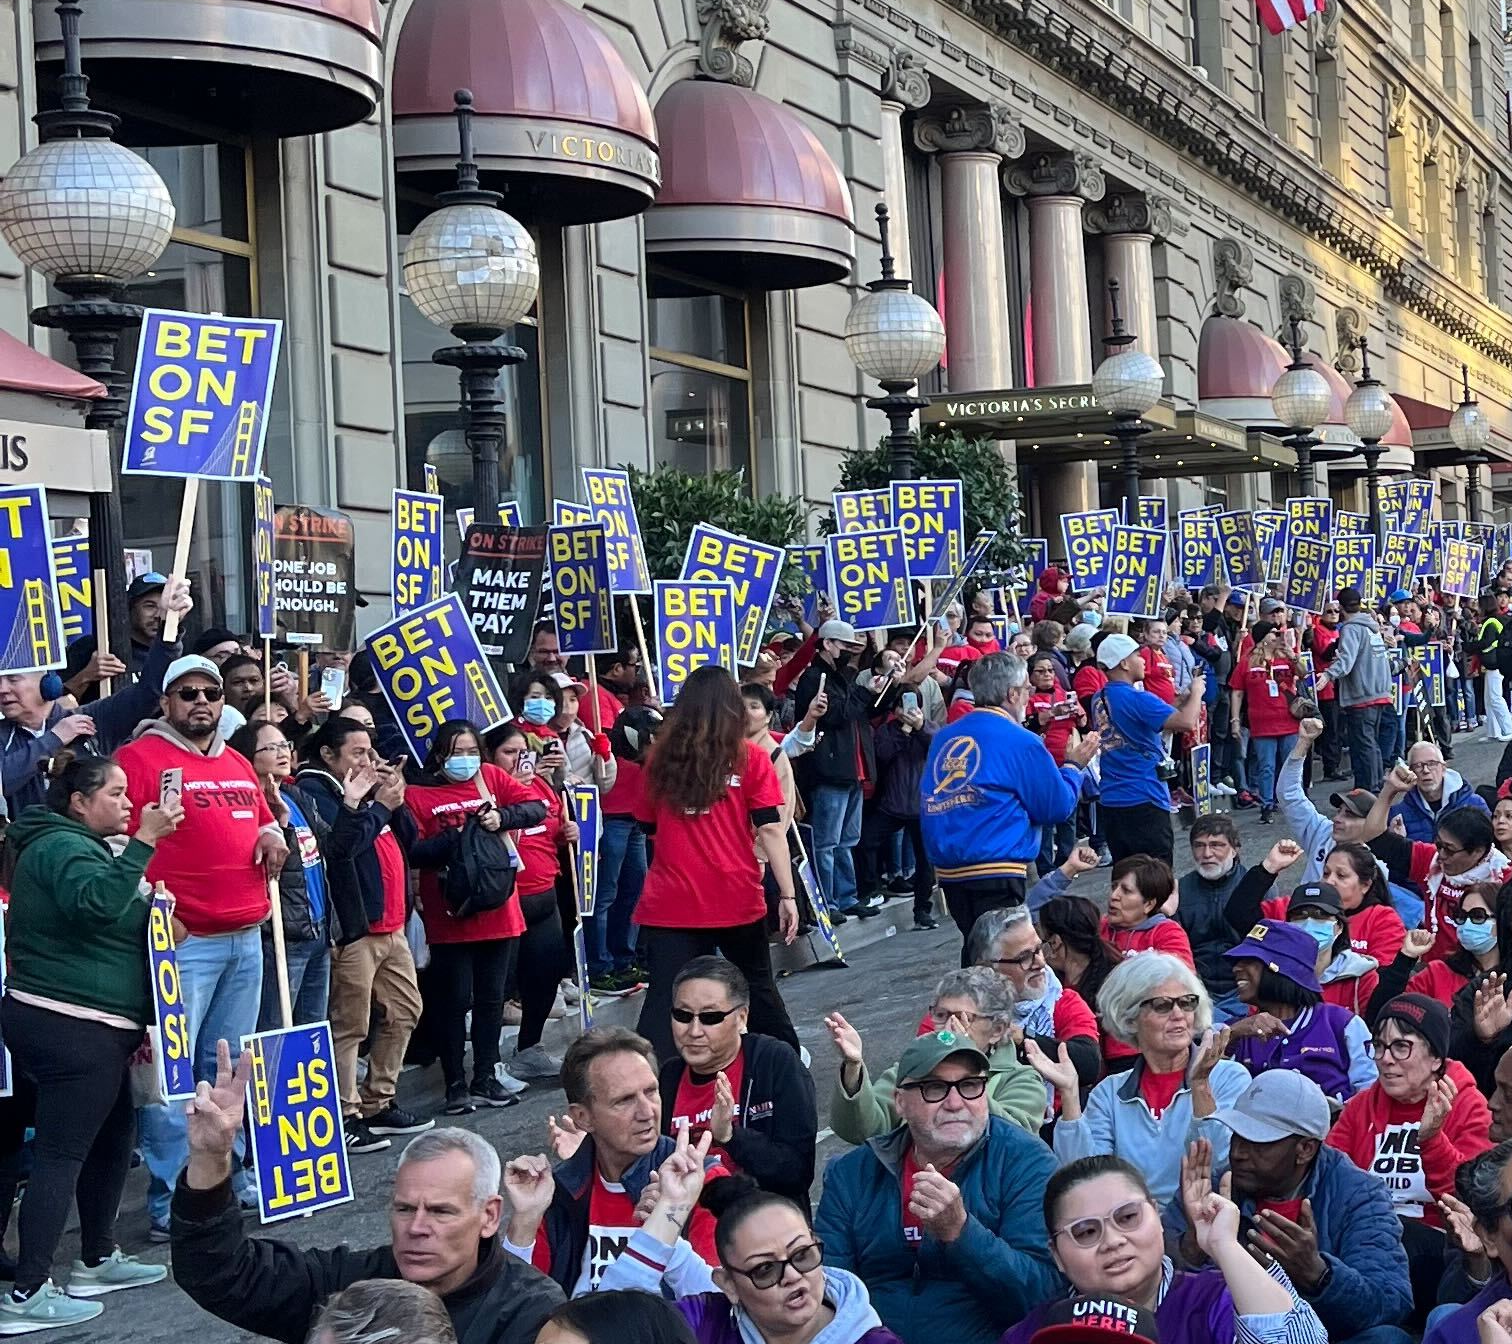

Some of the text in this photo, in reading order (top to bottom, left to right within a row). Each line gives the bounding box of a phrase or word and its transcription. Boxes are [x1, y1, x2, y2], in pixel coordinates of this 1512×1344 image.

[155, 319, 268, 365] BET
[148, 363, 237, 407] ON
[947, 397, 1043, 417] VICTORIA'S
[140, 406, 215, 446] SF
[589, 476, 627, 505] BET
[898, 485, 956, 509] BET
[1377, 484, 1407, 500] BET
[397, 498, 440, 534] BET
[841, 493, 890, 519] BET
[1139, 501, 1163, 518] ET
[1291, 502, 1329, 519] BET
[1379, 498, 1403, 512] ON
[289, 513, 348, 536] STRIKE
[597, 509, 630, 538] ON
[899, 511, 945, 536] ON
[1068, 513, 1114, 537] BET
[1184, 522, 1218, 539] BET
[1221, 514, 1251, 535] BET
[1290, 519, 1320, 536] ON
[1339, 514, 1369, 531] BET
[470, 532, 545, 551] ON STRIKE
[551, 529, 602, 563] BET
[837, 533, 898, 563] BET
[1072, 535, 1109, 556] ON
[1116, 530, 1163, 555] BET
[1184, 540, 1212, 558] ON
[1226, 536, 1252, 554] ON
[1296, 541, 1331, 563] BET
[1335, 539, 1372, 556] BET
[1388, 535, 1419, 552] BET
[1449, 542, 1480, 560] BET
[396, 536, 431, 570] ON
[696, 535, 776, 579] BET
[1385, 550, 1407, 566] ON
[273, 560, 338, 576] ONE JOB
[840, 560, 890, 587] ON
[1076, 556, 1104, 577] SF
[1114, 554, 1147, 577] ON
[1184, 559, 1206, 576] SF
[1229, 555, 1250, 574] SF
[1293, 560, 1320, 580] ON
[1335, 557, 1364, 573] ON
[1375, 566, 1397, 584] ET
[1448, 556, 1471, 573] ON
[326, 581, 347, 595] BE
[471, 568, 532, 589] MAKE
[555, 565, 596, 596] ON
[1111, 578, 1137, 599] SF
[1291, 578, 1313, 596] SF
[1335, 574, 1358, 591] SF
[1446, 570, 1465, 585] SF
[396, 573, 423, 606] SF
[469, 590, 528, 610] THEM
[843, 587, 882, 614] SF
[664, 588, 727, 617] BET
[471, 612, 513, 634] PAY.
[559, 600, 592, 631] SF
[370, 603, 454, 671] BET
[665, 621, 717, 649] ON
[391, 646, 458, 701] ON
[406, 686, 455, 739] SF
[286, 1057, 329, 1102] SF
[278, 1109, 335, 1155] ON
[269, 1151, 342, 1210] BET
[1072, 1299, 1139, 1324] UNITE
